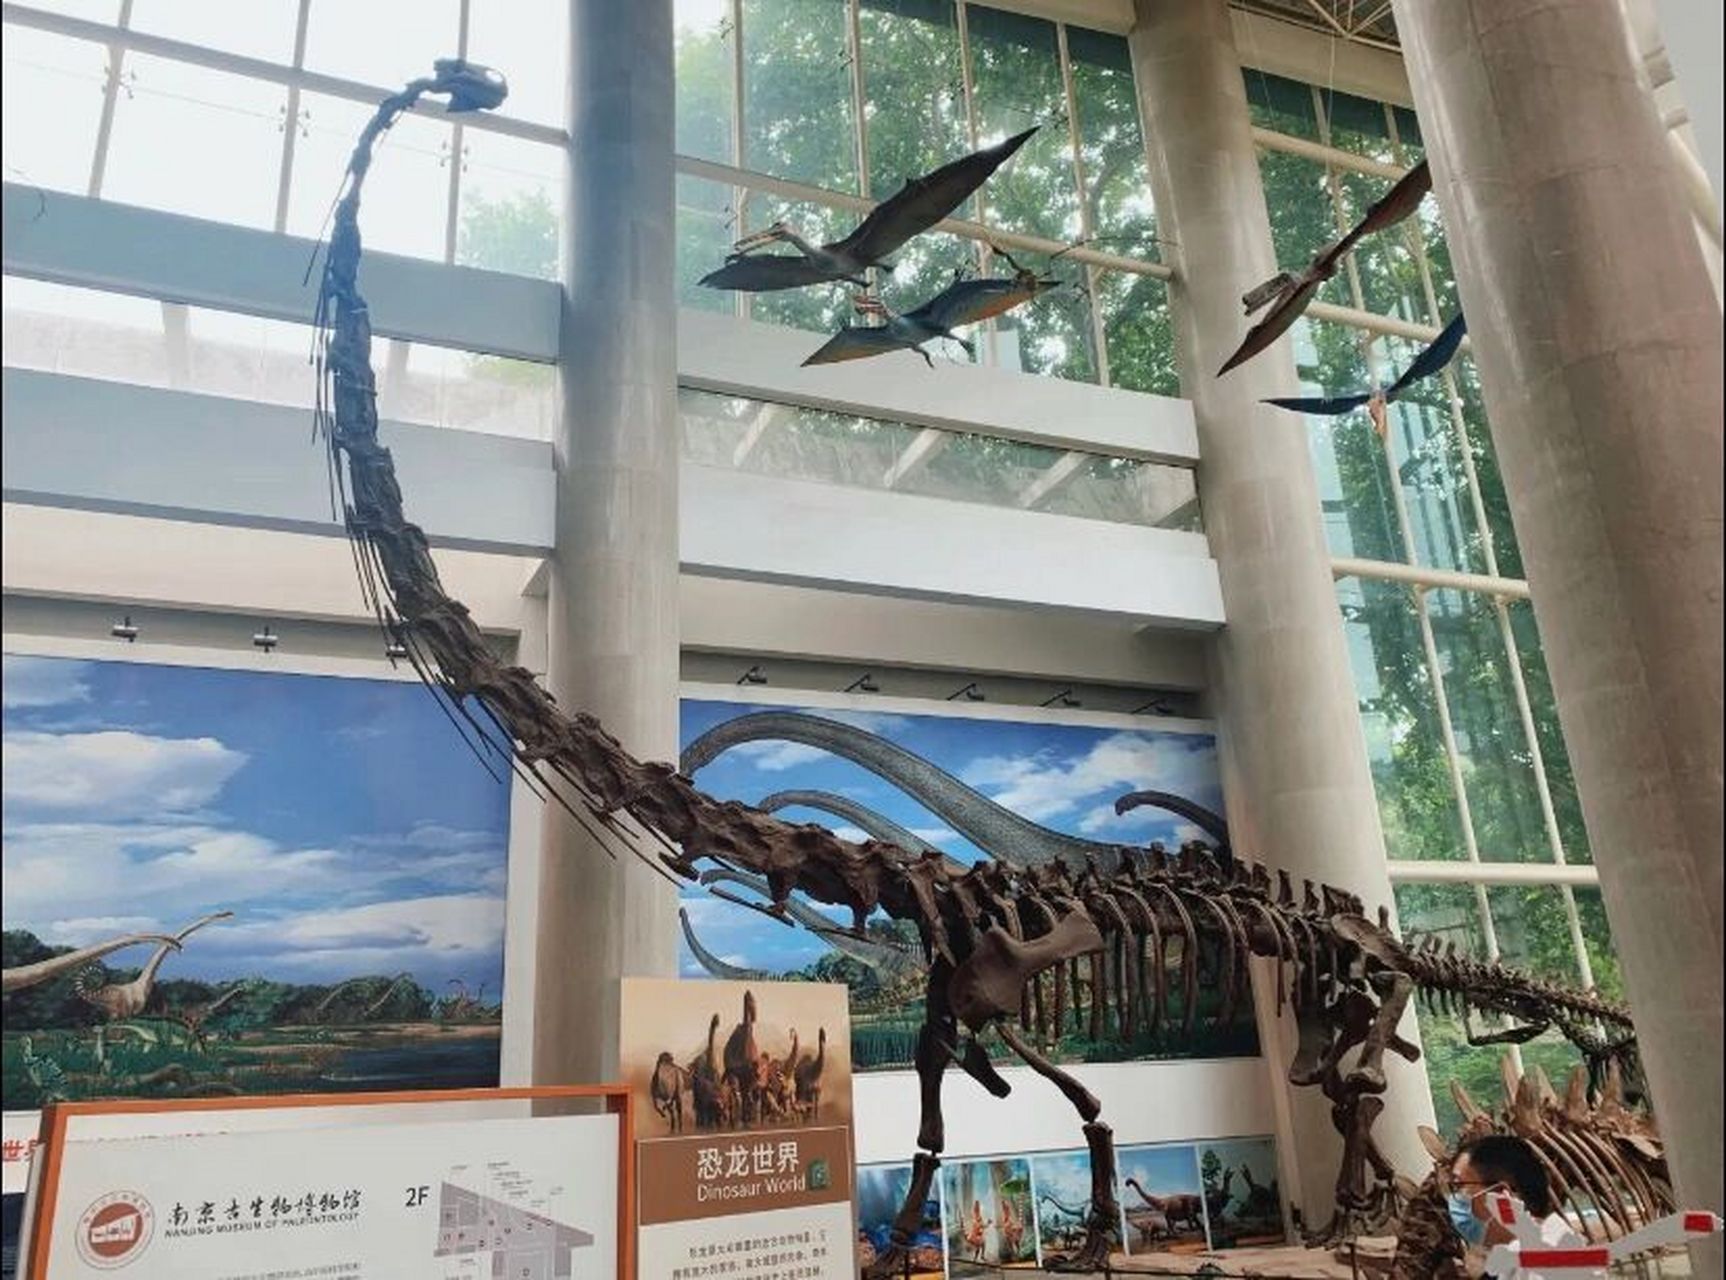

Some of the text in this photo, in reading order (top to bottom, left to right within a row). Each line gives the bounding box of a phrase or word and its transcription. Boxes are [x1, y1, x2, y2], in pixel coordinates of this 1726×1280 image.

[697, 1141, 799, 1180] 恐龙世界
[405, 1186, 430, 1208] 2F
[697, 1173, 806, 1202] Dinosaur World
[164, 1227, 214, 1239] NANJING
[216, 1221, 262, 1234] MUSEUM
[264, 1219, 279, 1230] OF
